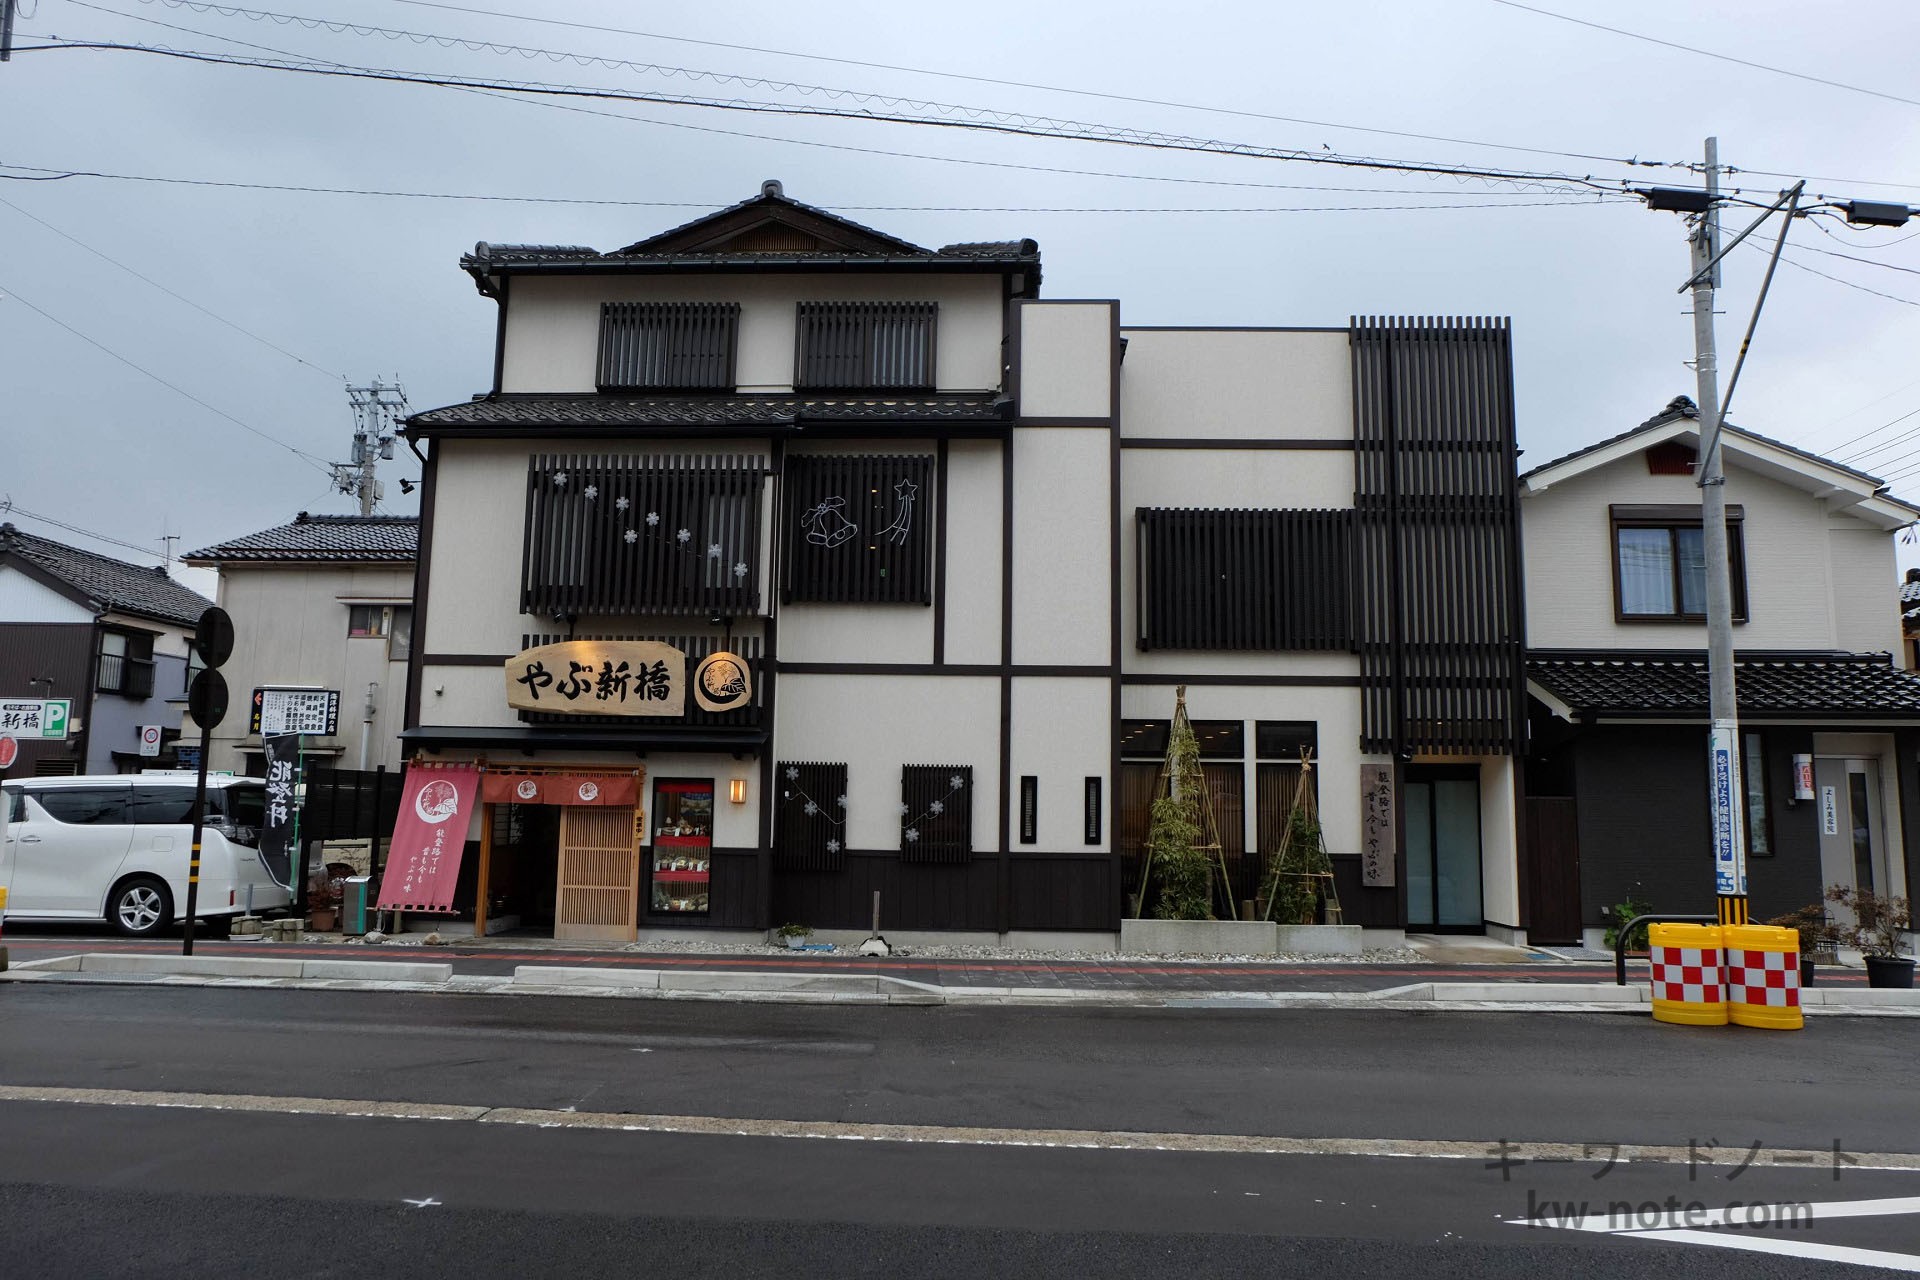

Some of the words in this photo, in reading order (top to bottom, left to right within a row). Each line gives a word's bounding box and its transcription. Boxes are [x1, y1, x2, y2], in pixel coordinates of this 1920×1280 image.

[517, 660, 670, 703] やぶ新橋
[2, 713, 39, 729] 新橋
